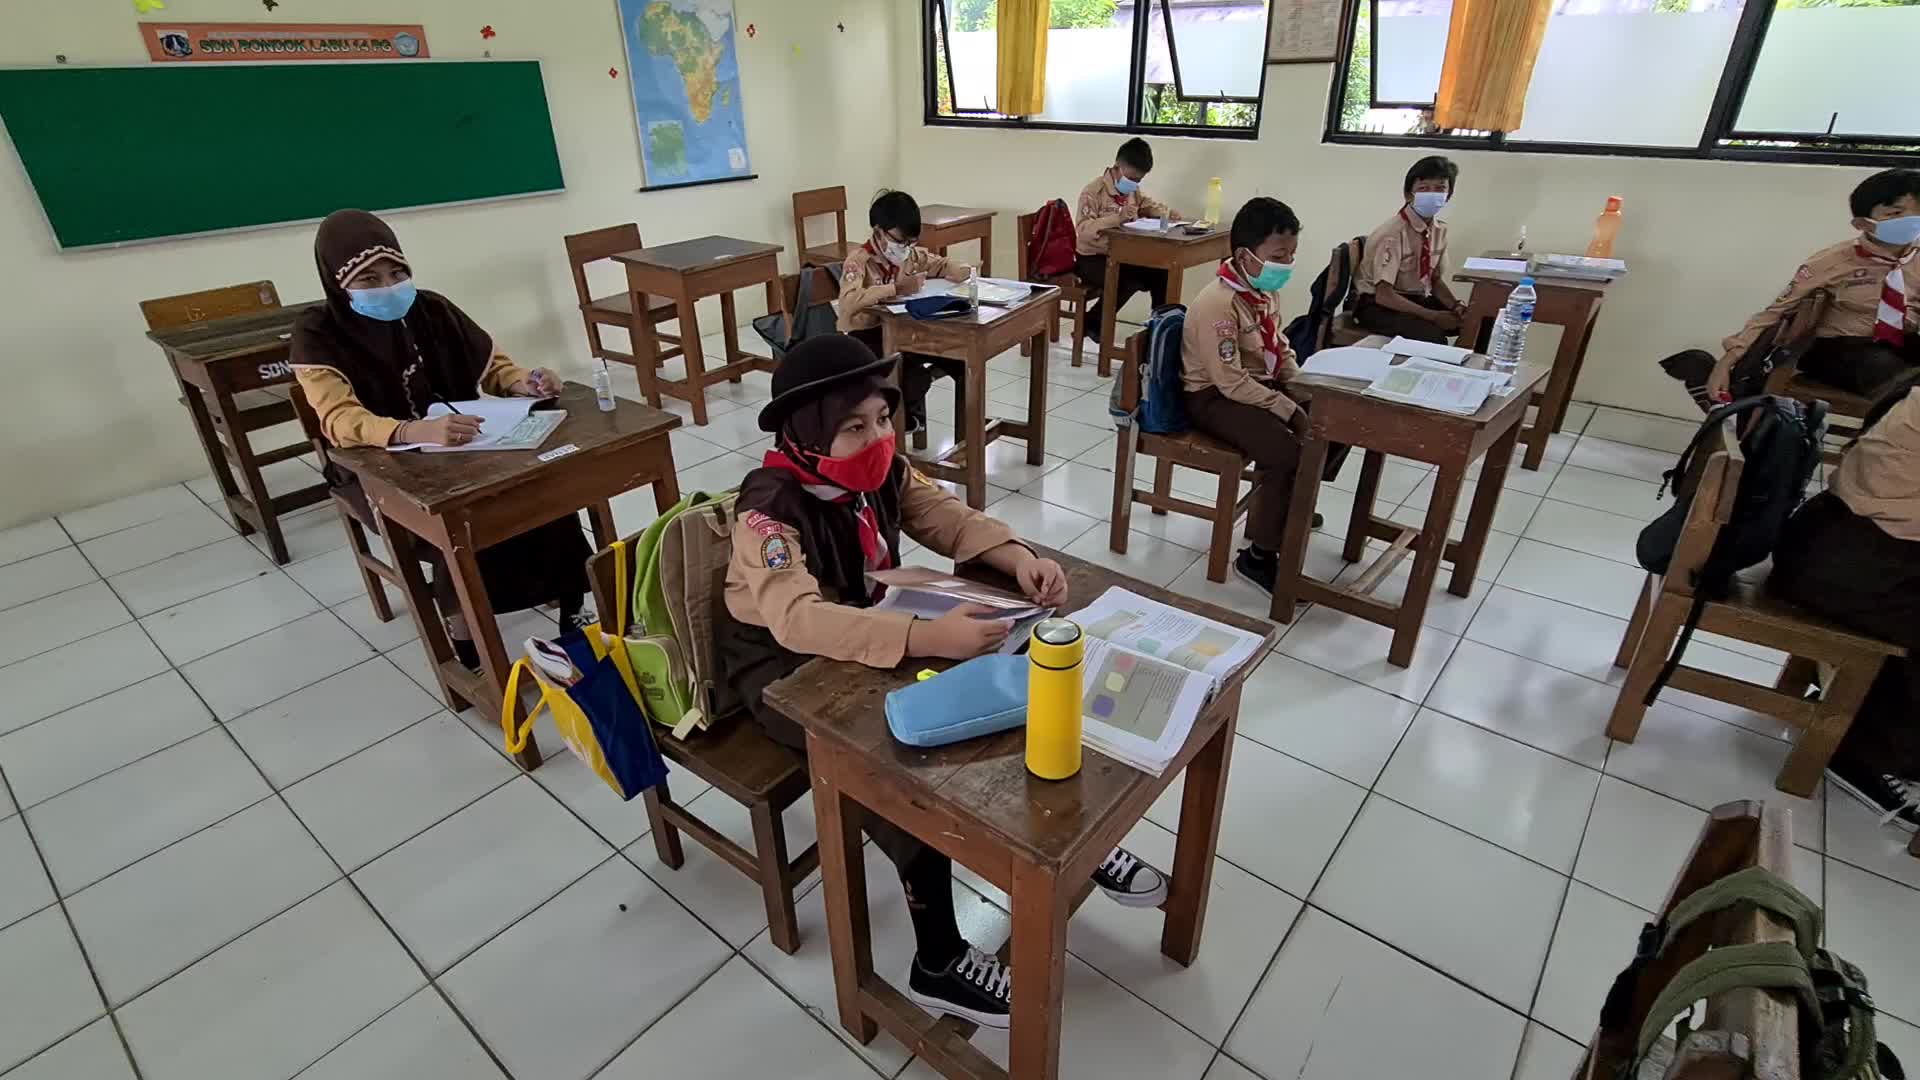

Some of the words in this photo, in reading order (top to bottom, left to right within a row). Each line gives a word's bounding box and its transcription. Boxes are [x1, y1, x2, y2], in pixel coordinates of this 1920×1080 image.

[199, 39, 236, 53] SDN
[238, 39, 308, 53] PONDOK
[310, 39, 351, 52] LABU
